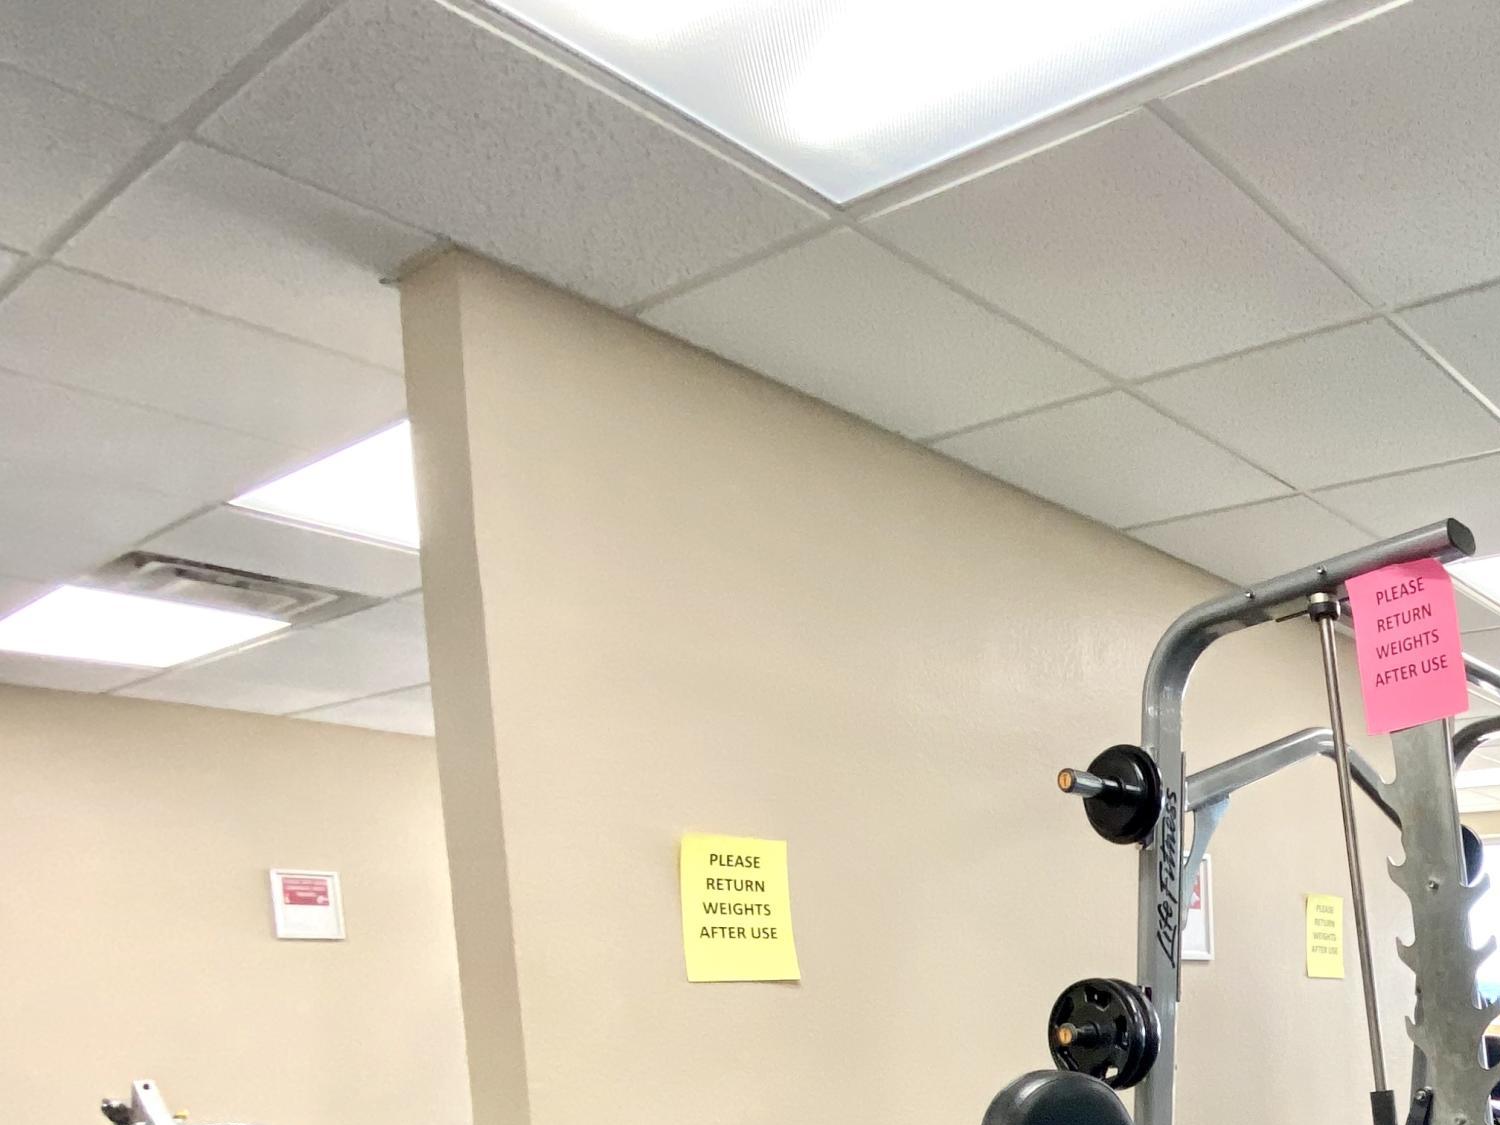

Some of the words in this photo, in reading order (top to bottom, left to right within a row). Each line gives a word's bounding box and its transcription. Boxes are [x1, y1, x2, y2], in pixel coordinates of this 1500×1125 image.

[1376, 577, 1425, 605] PLEASE
[1377, 603, 1432, 632] RETURN
[1376, 629, 1440, 659] WEIGHTS
[1376, 664, 1418, 687] AFTER
[1421, 654, 1448, 674] USE
[709, 853, 761, 869] PLEASE
[706, 877, 766, 892] RETURN
[702, 901, 772, 916] WEIGHTS
[699, 926, 746, 939] AFTER
[751, 927, 778, 939] USE
